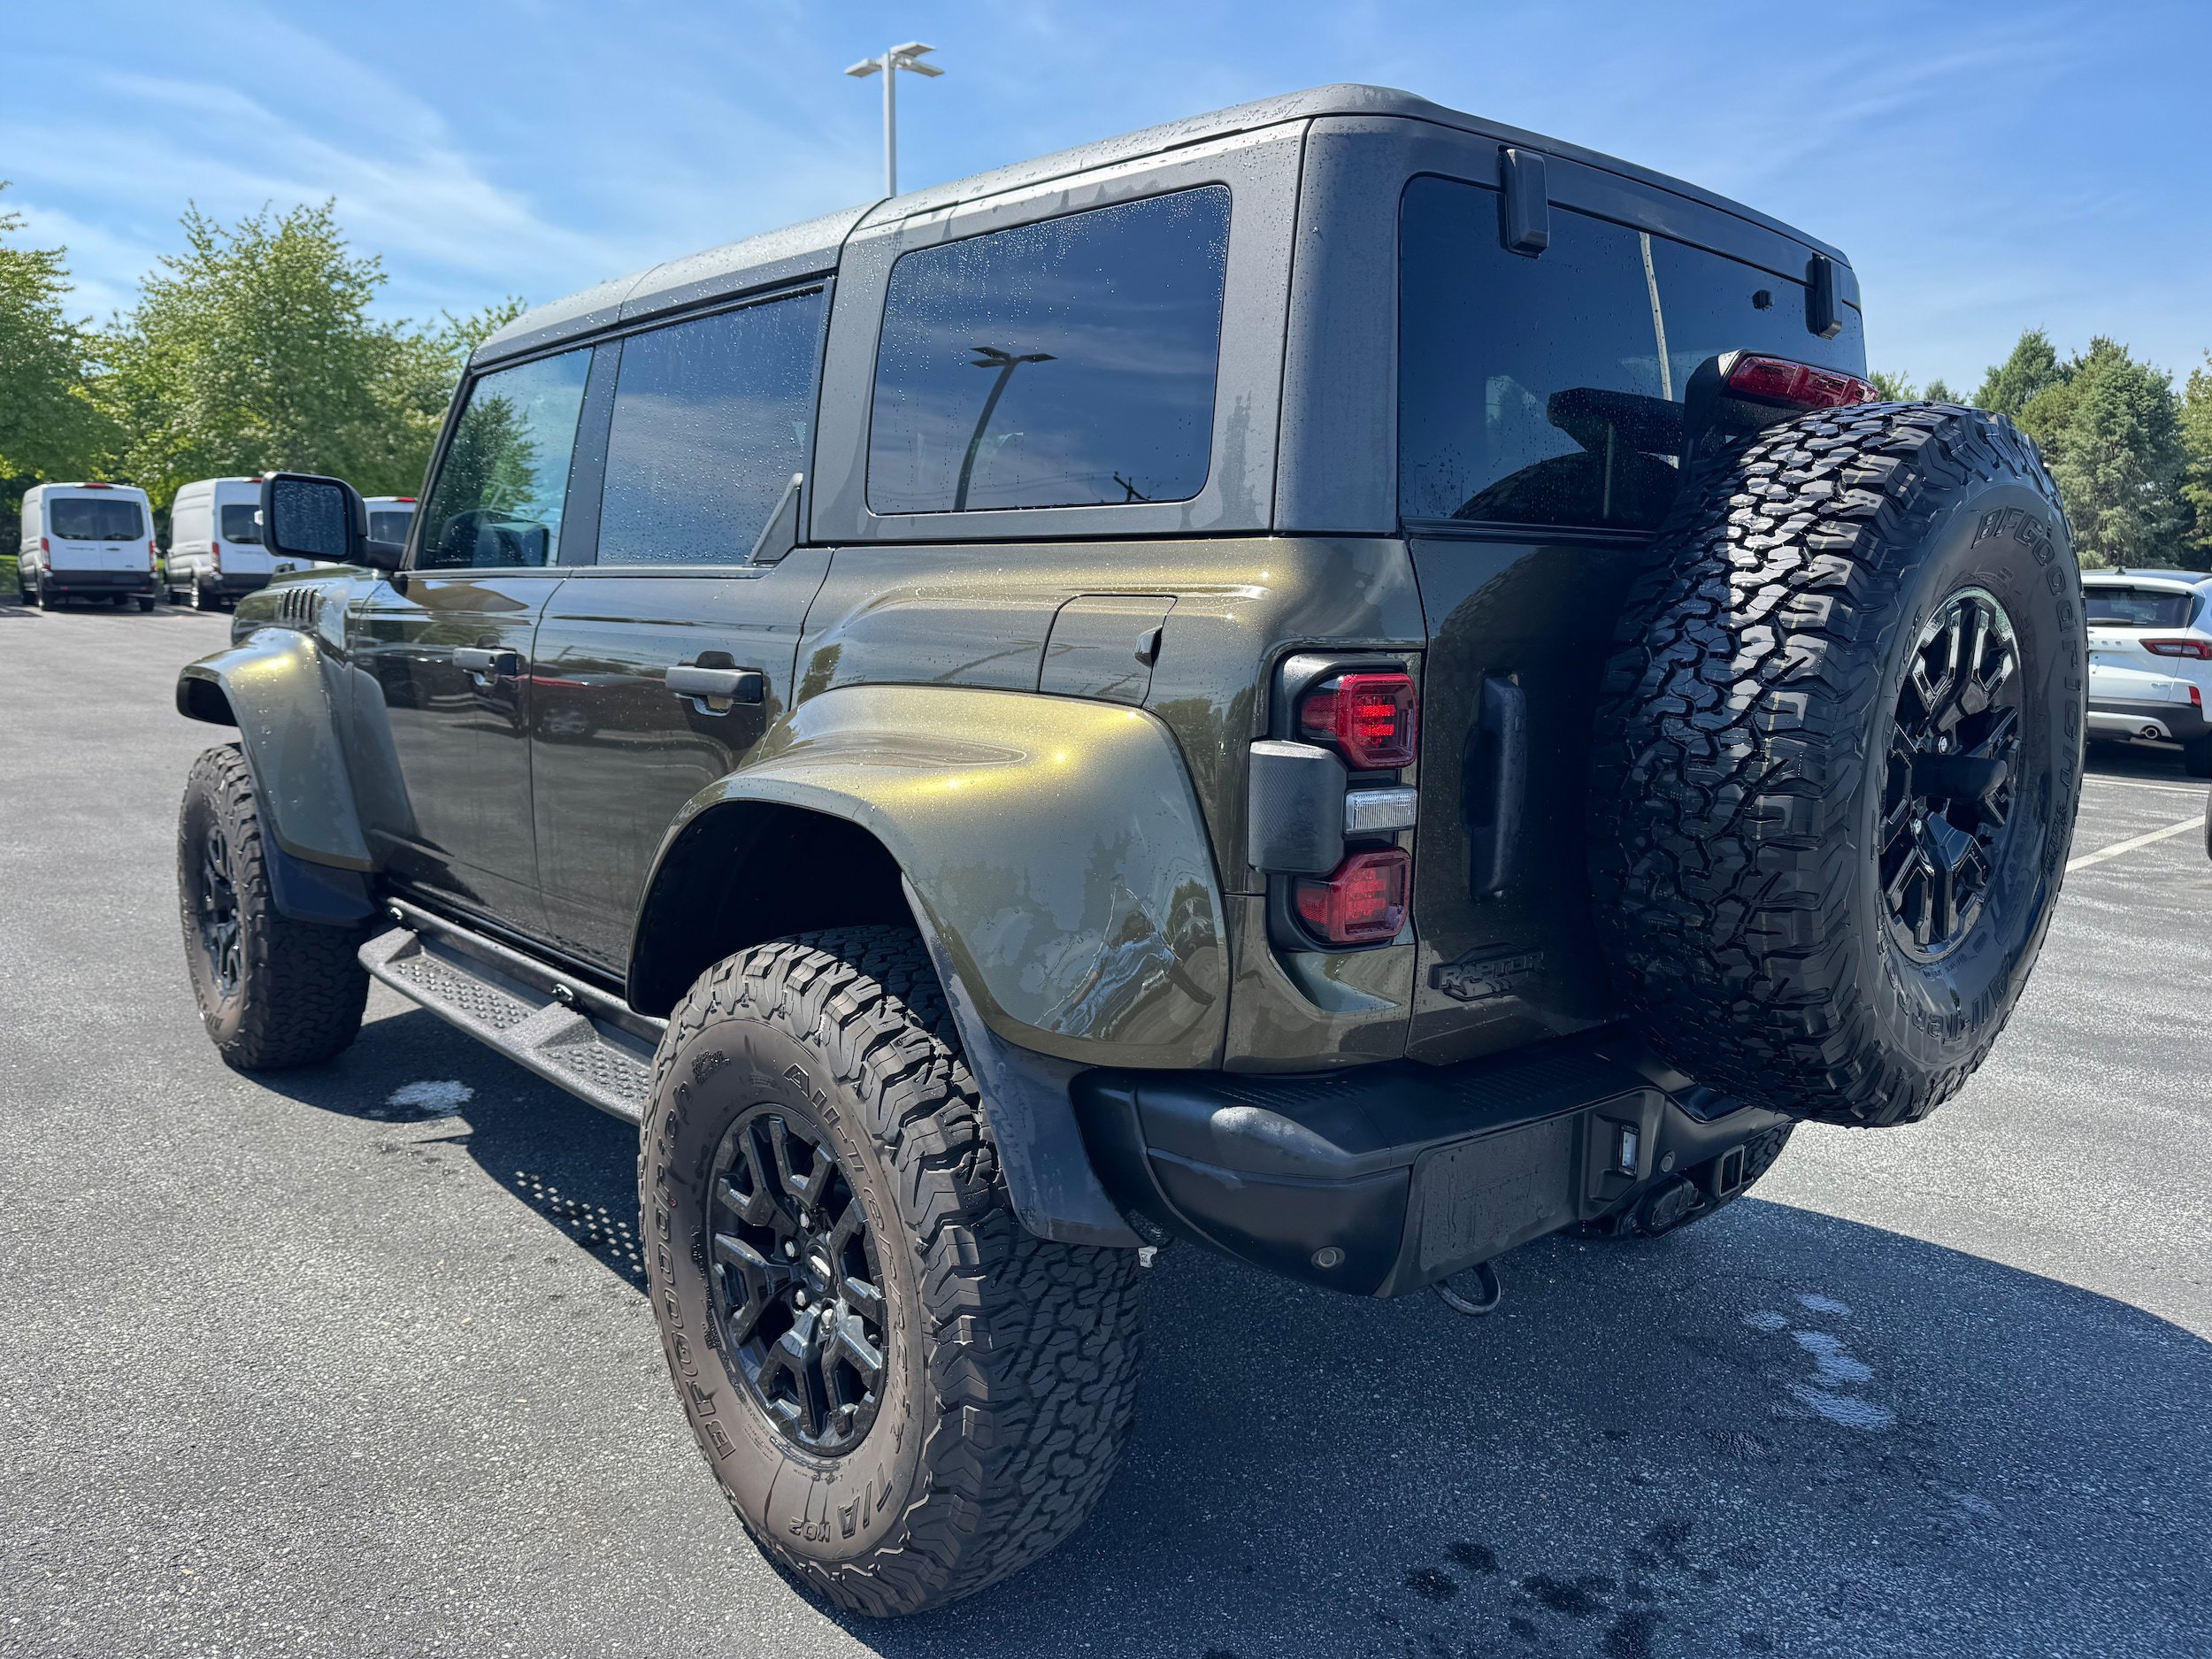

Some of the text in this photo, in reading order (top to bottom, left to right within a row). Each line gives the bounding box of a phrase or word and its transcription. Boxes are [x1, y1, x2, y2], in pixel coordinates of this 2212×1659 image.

[1970, 505, 2081, 789] BFGoodrich
[1440, 951, 1544, 989] RAPTOR
[652, 1081, 736, 1459] BFGoodrich
[782, 1063, 911, 1454] All-Terrain
[788, 1516, 830, 1543] KO2
